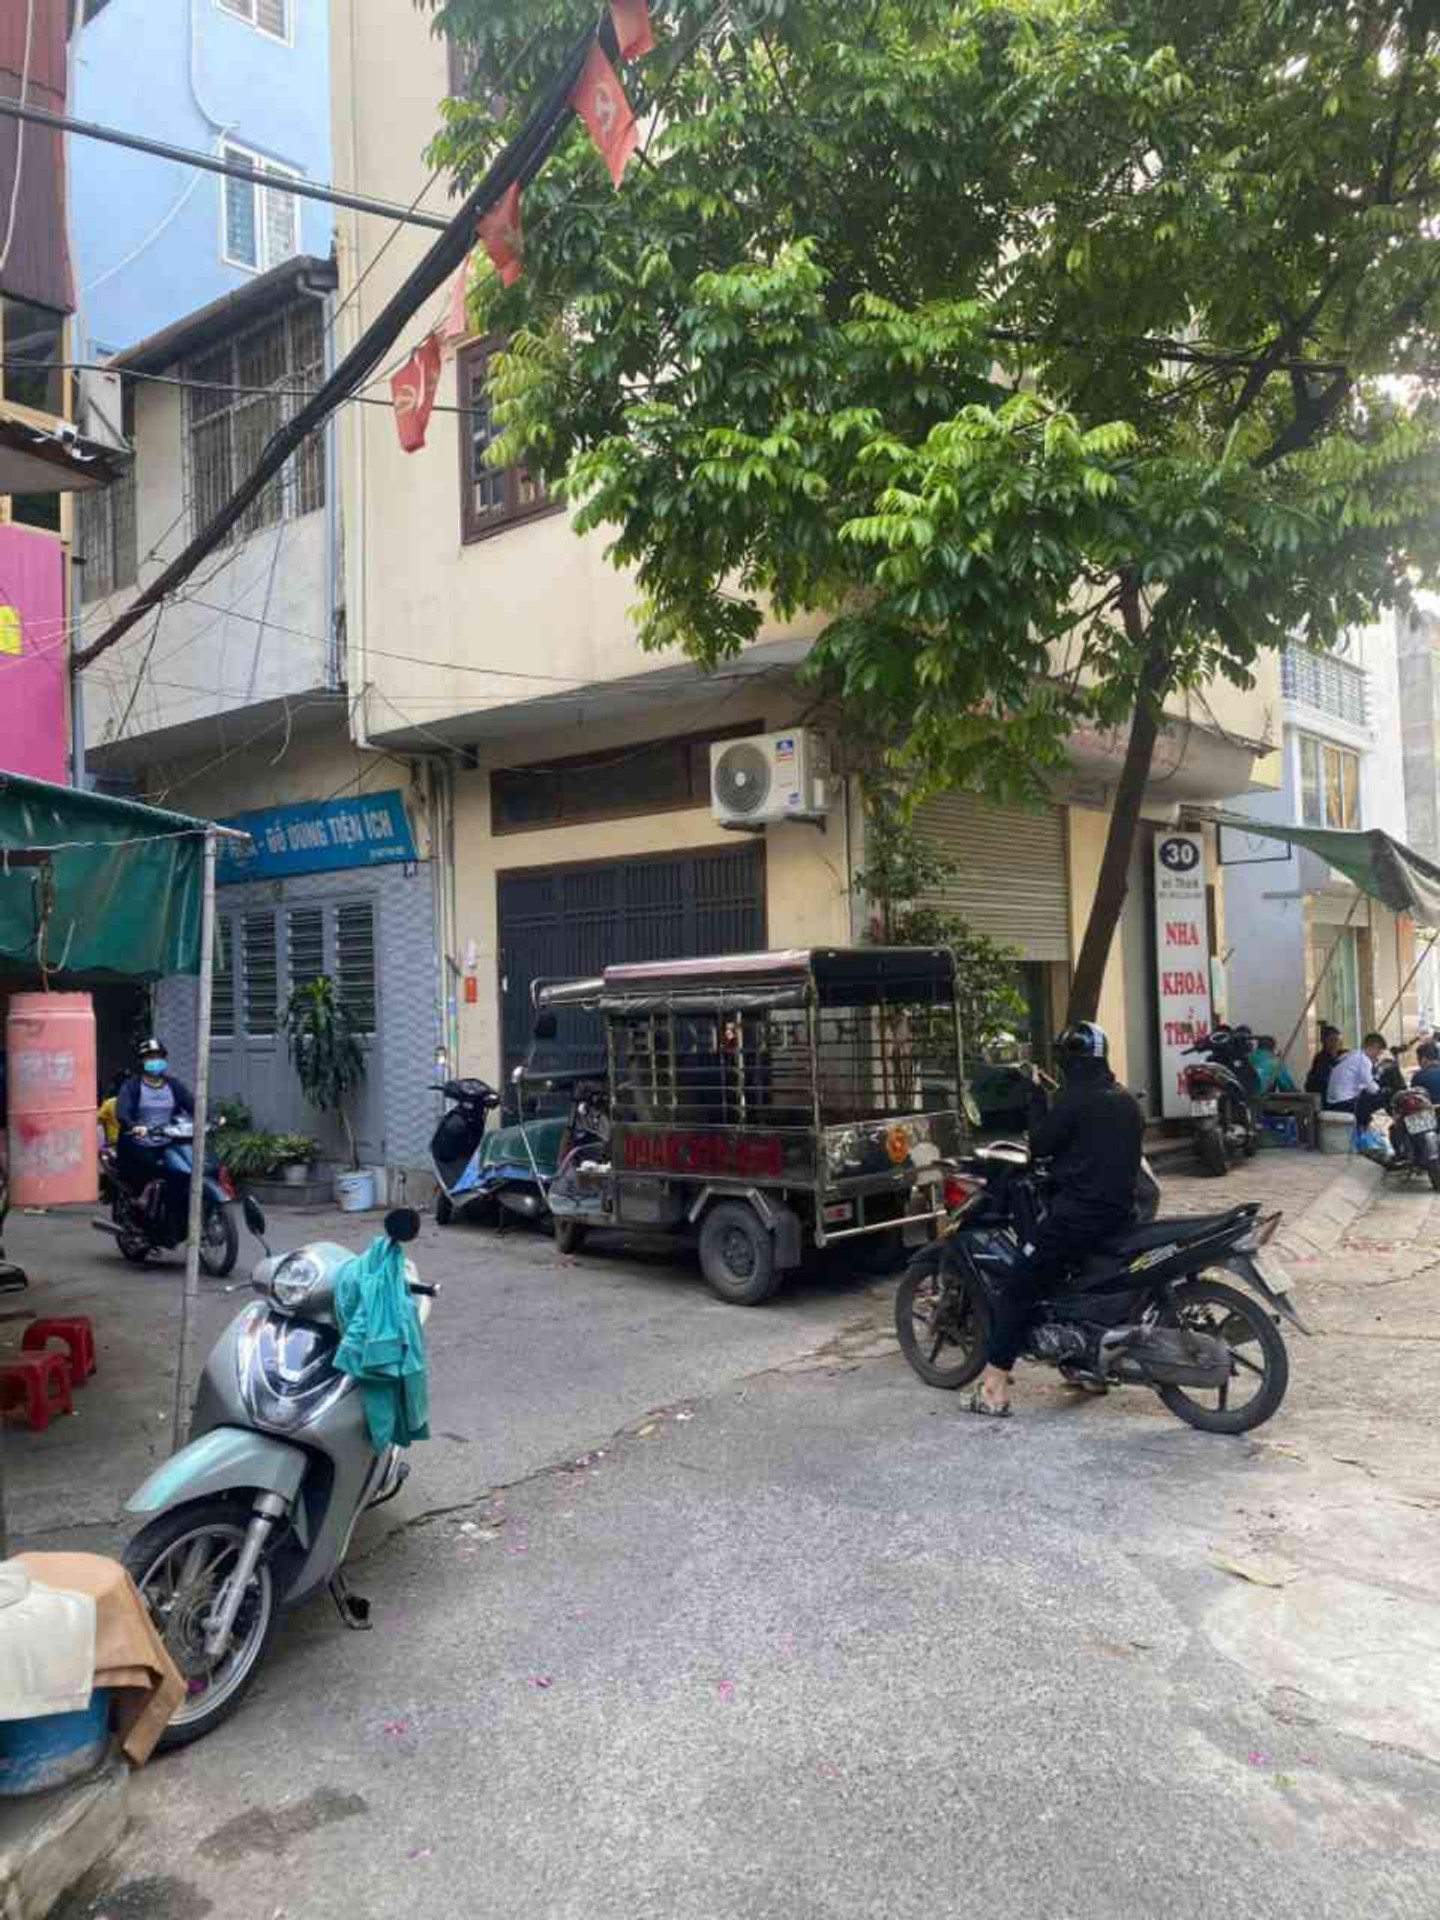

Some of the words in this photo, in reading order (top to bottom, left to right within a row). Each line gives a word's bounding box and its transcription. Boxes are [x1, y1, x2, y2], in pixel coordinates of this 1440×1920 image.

[1166, 843, 1195, 864] 30
[1165, 921, 1200, 946] NHA
[1162, 972, 1206, 996] KHOA
